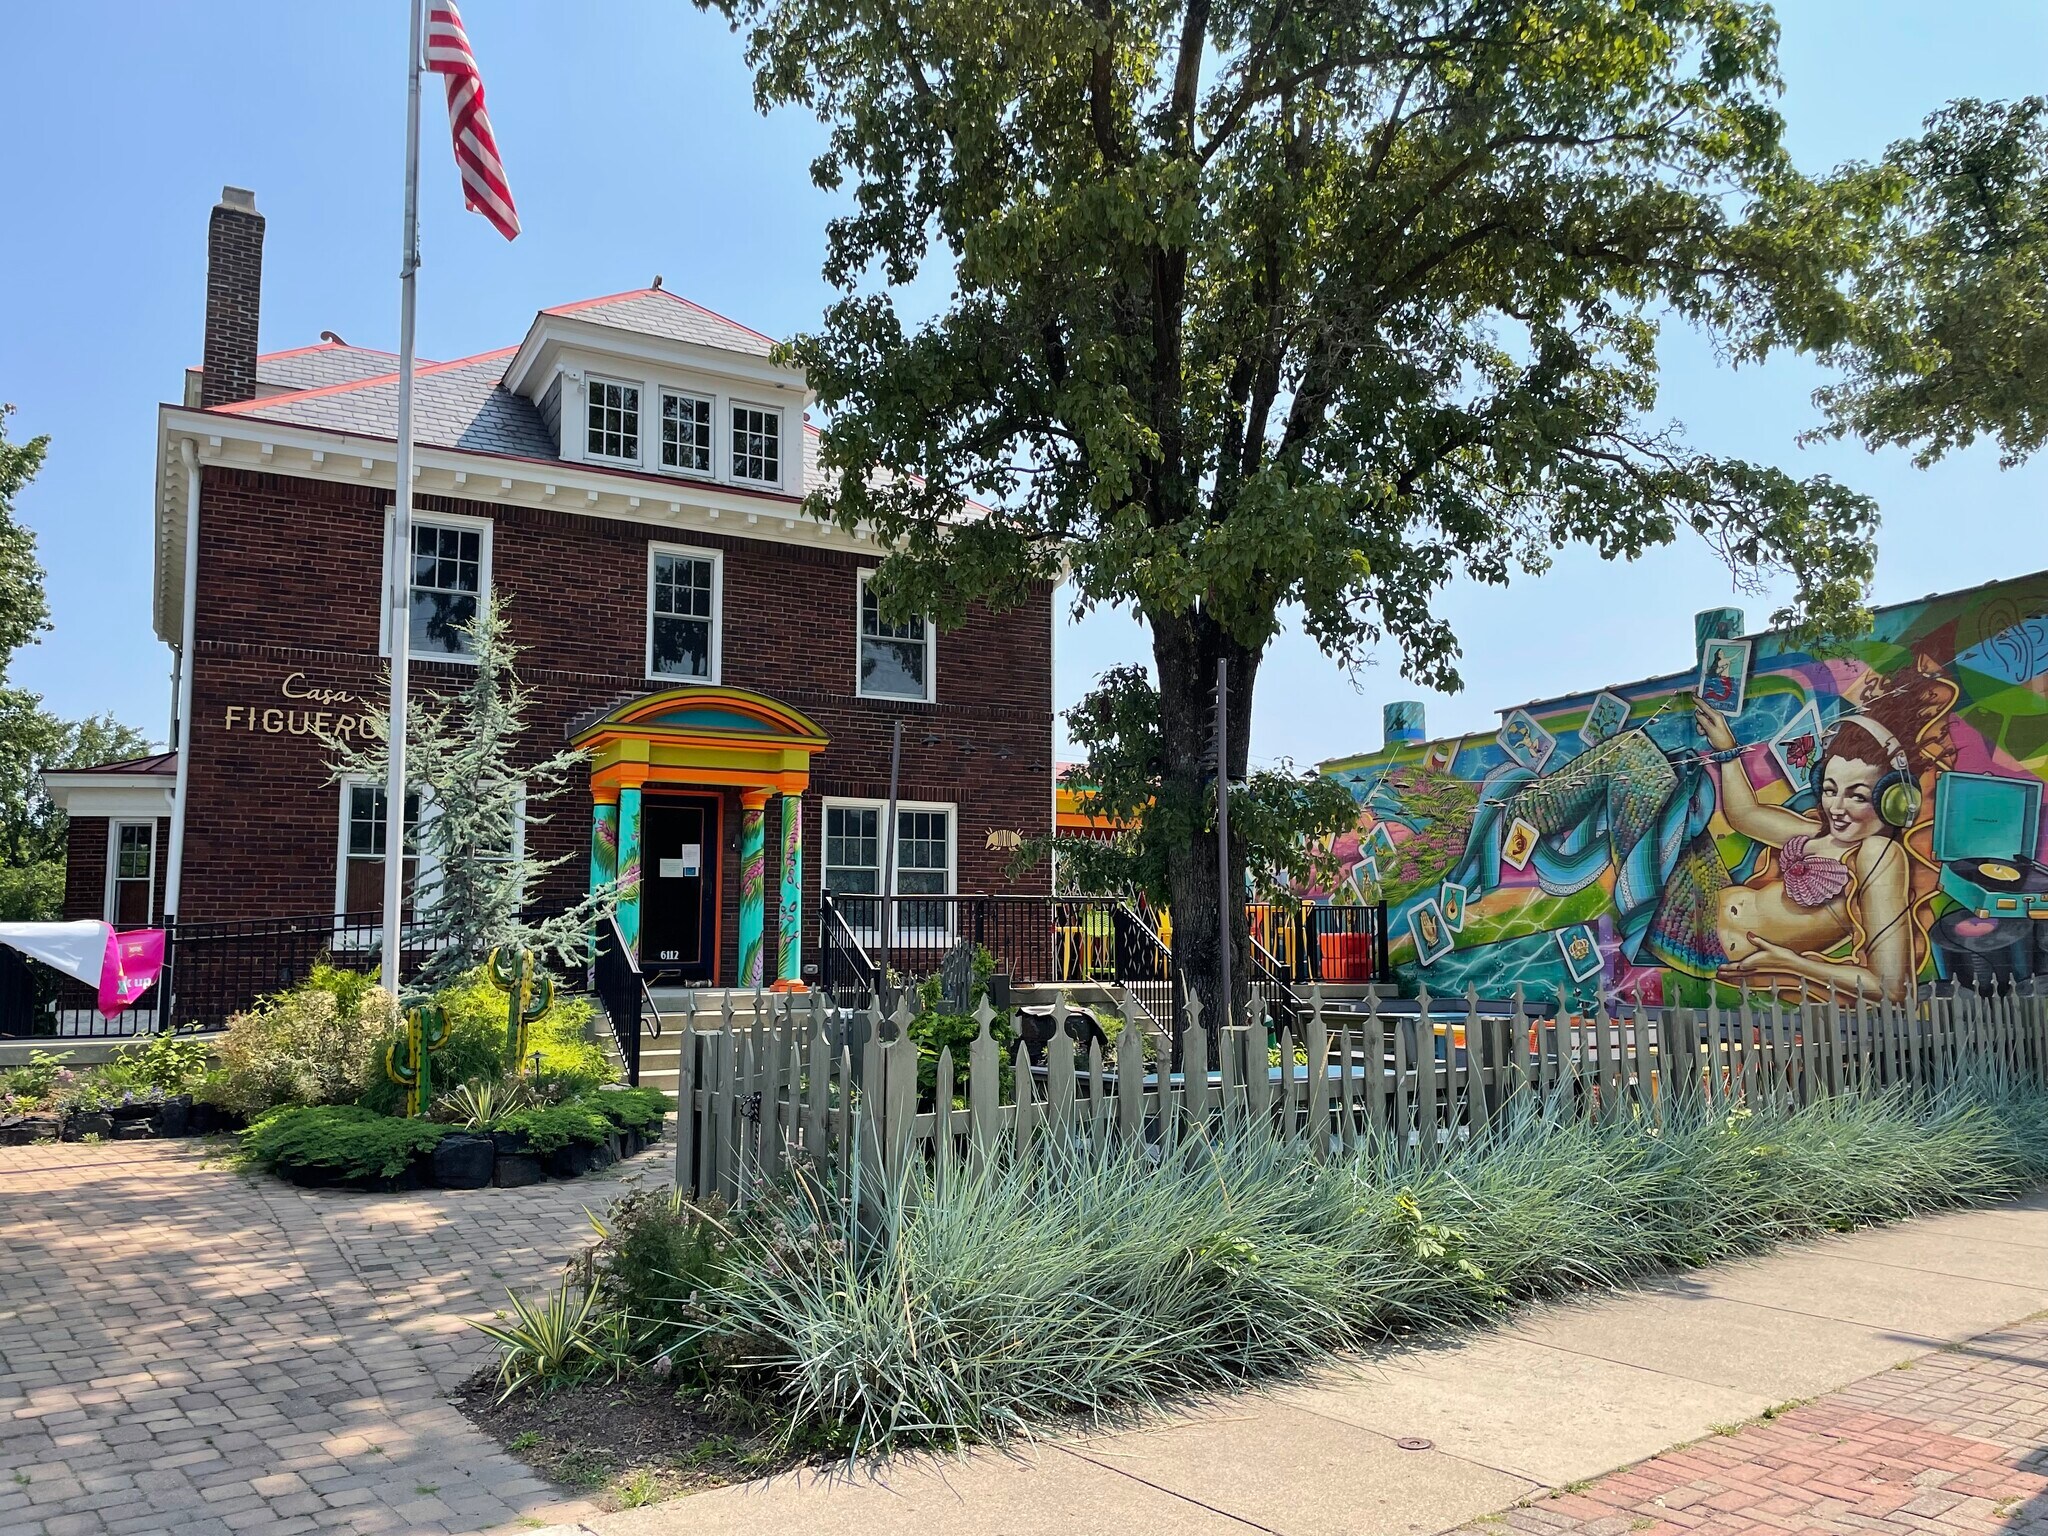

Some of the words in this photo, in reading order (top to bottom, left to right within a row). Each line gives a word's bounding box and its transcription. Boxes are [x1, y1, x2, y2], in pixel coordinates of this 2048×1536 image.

[282, 673, 354, 704] Casa
[661, 951, 679, 960] 6112
[135, 978, 151, 989] up
